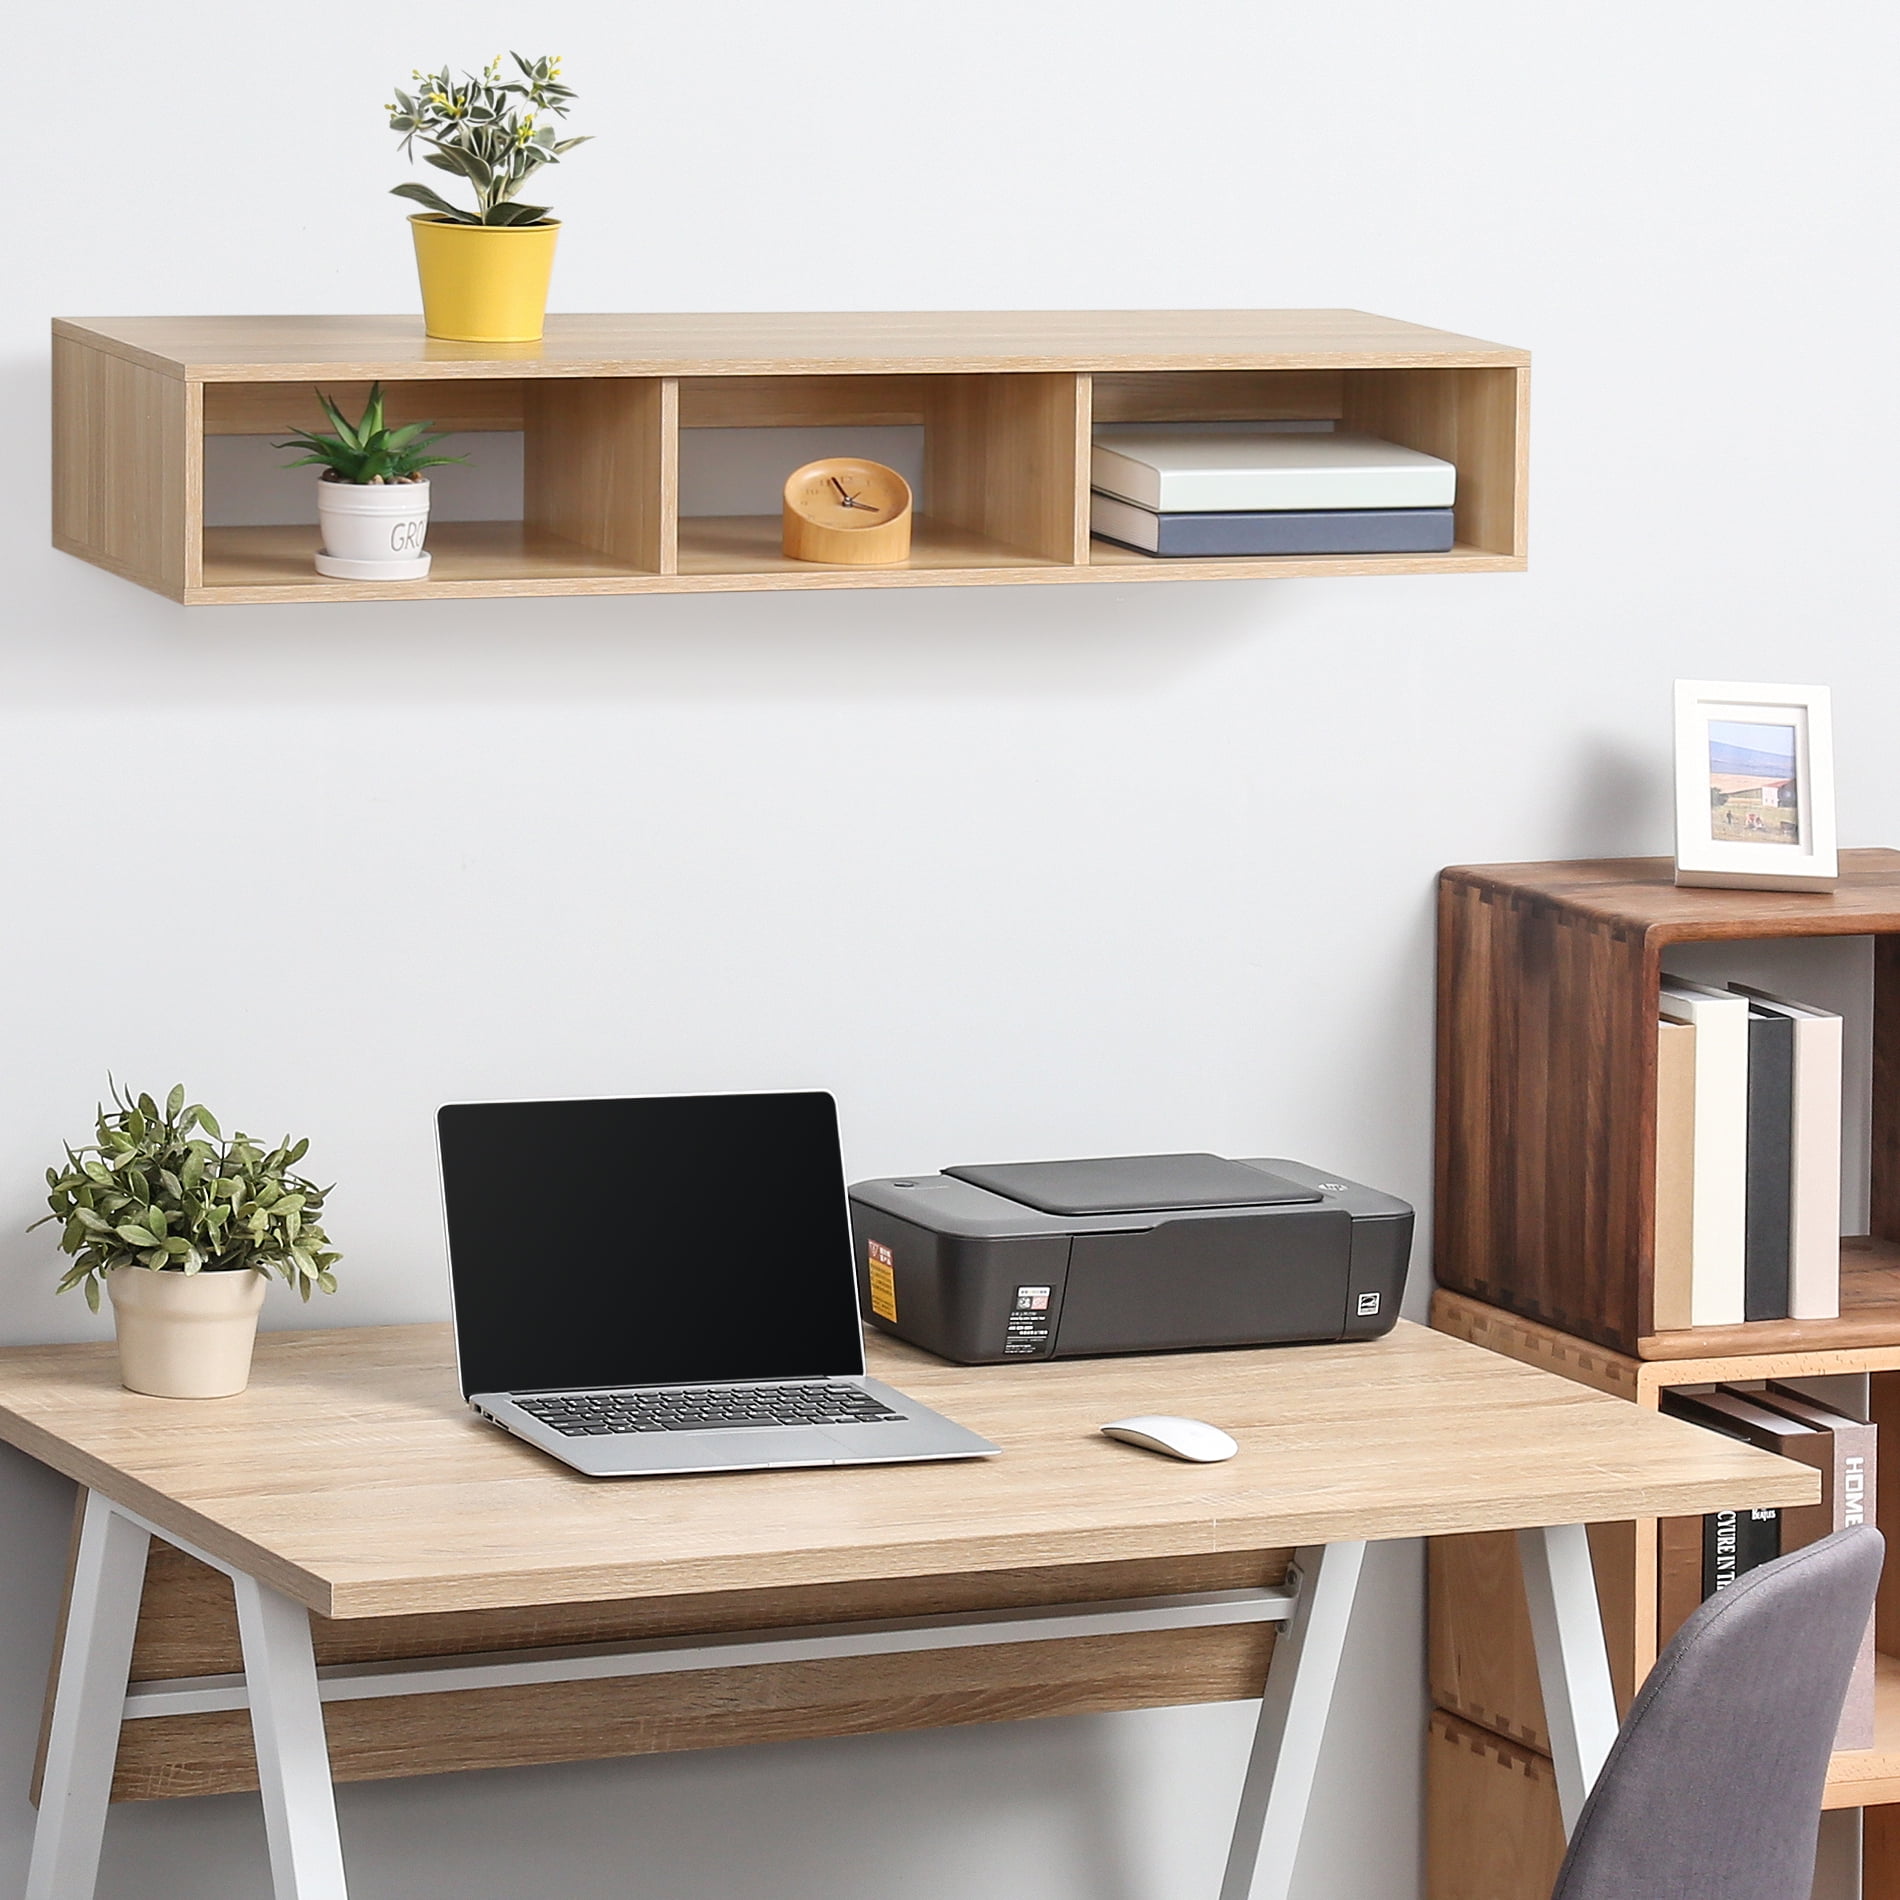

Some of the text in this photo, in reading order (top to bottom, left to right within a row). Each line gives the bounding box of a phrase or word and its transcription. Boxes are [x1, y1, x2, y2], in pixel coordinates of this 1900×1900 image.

[1845, 1457, 1864, 1529] HOME
[1717, 1510, 1736, 1555] CYURE
[1717, 1555, 1736, 1570] IN
